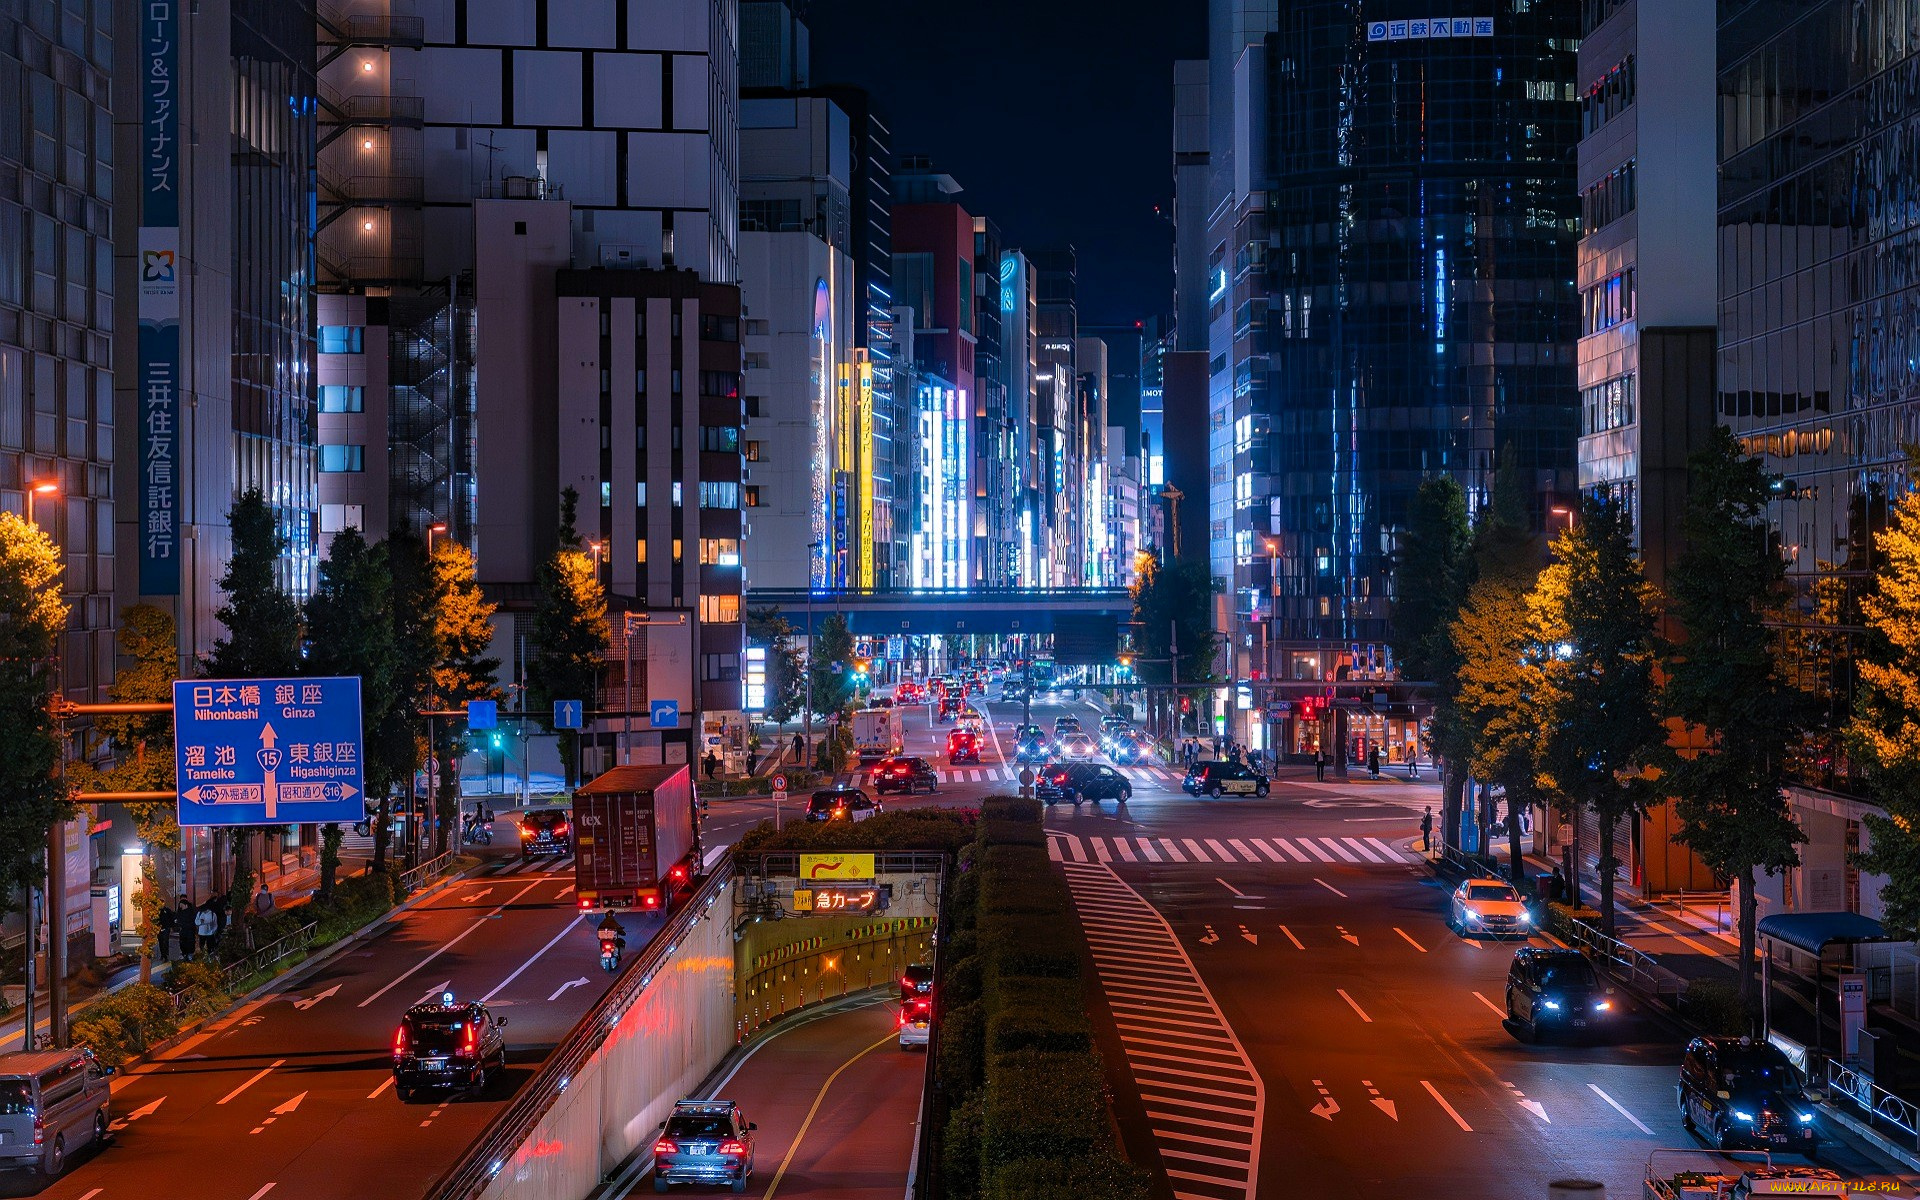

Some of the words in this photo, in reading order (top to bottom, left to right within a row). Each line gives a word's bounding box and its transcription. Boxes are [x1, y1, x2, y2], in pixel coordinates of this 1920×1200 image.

[1390, 20, 1492, 36] 近鉄不動産
[147, 362, 172, 559] 三井住友信託銀行
[193, 685, 261, 707] 日本橋
[274, 684, 323, 705] 銀座
[194, 708, 259, 721] Nihonbashi
[282, 707, 316, 719] Ginza
[184, 745, 236, 767] 溜池
[262, 752, 277, 766] 15
[288, 741, 357, 764] 東銀座
[185, 768, 236, 780] Tameike
[290, 766, 356, 779] Higashiginza
[200, 789, 218, 800] 405
[219, 788, 259, 800] 外堀通り
[282, 786, 321, 799] 昭和通り
[324, 786, 340, 797] 316
[581, 813, 602, 826] tex
[816, 891, 875, 908] 急カーブ
